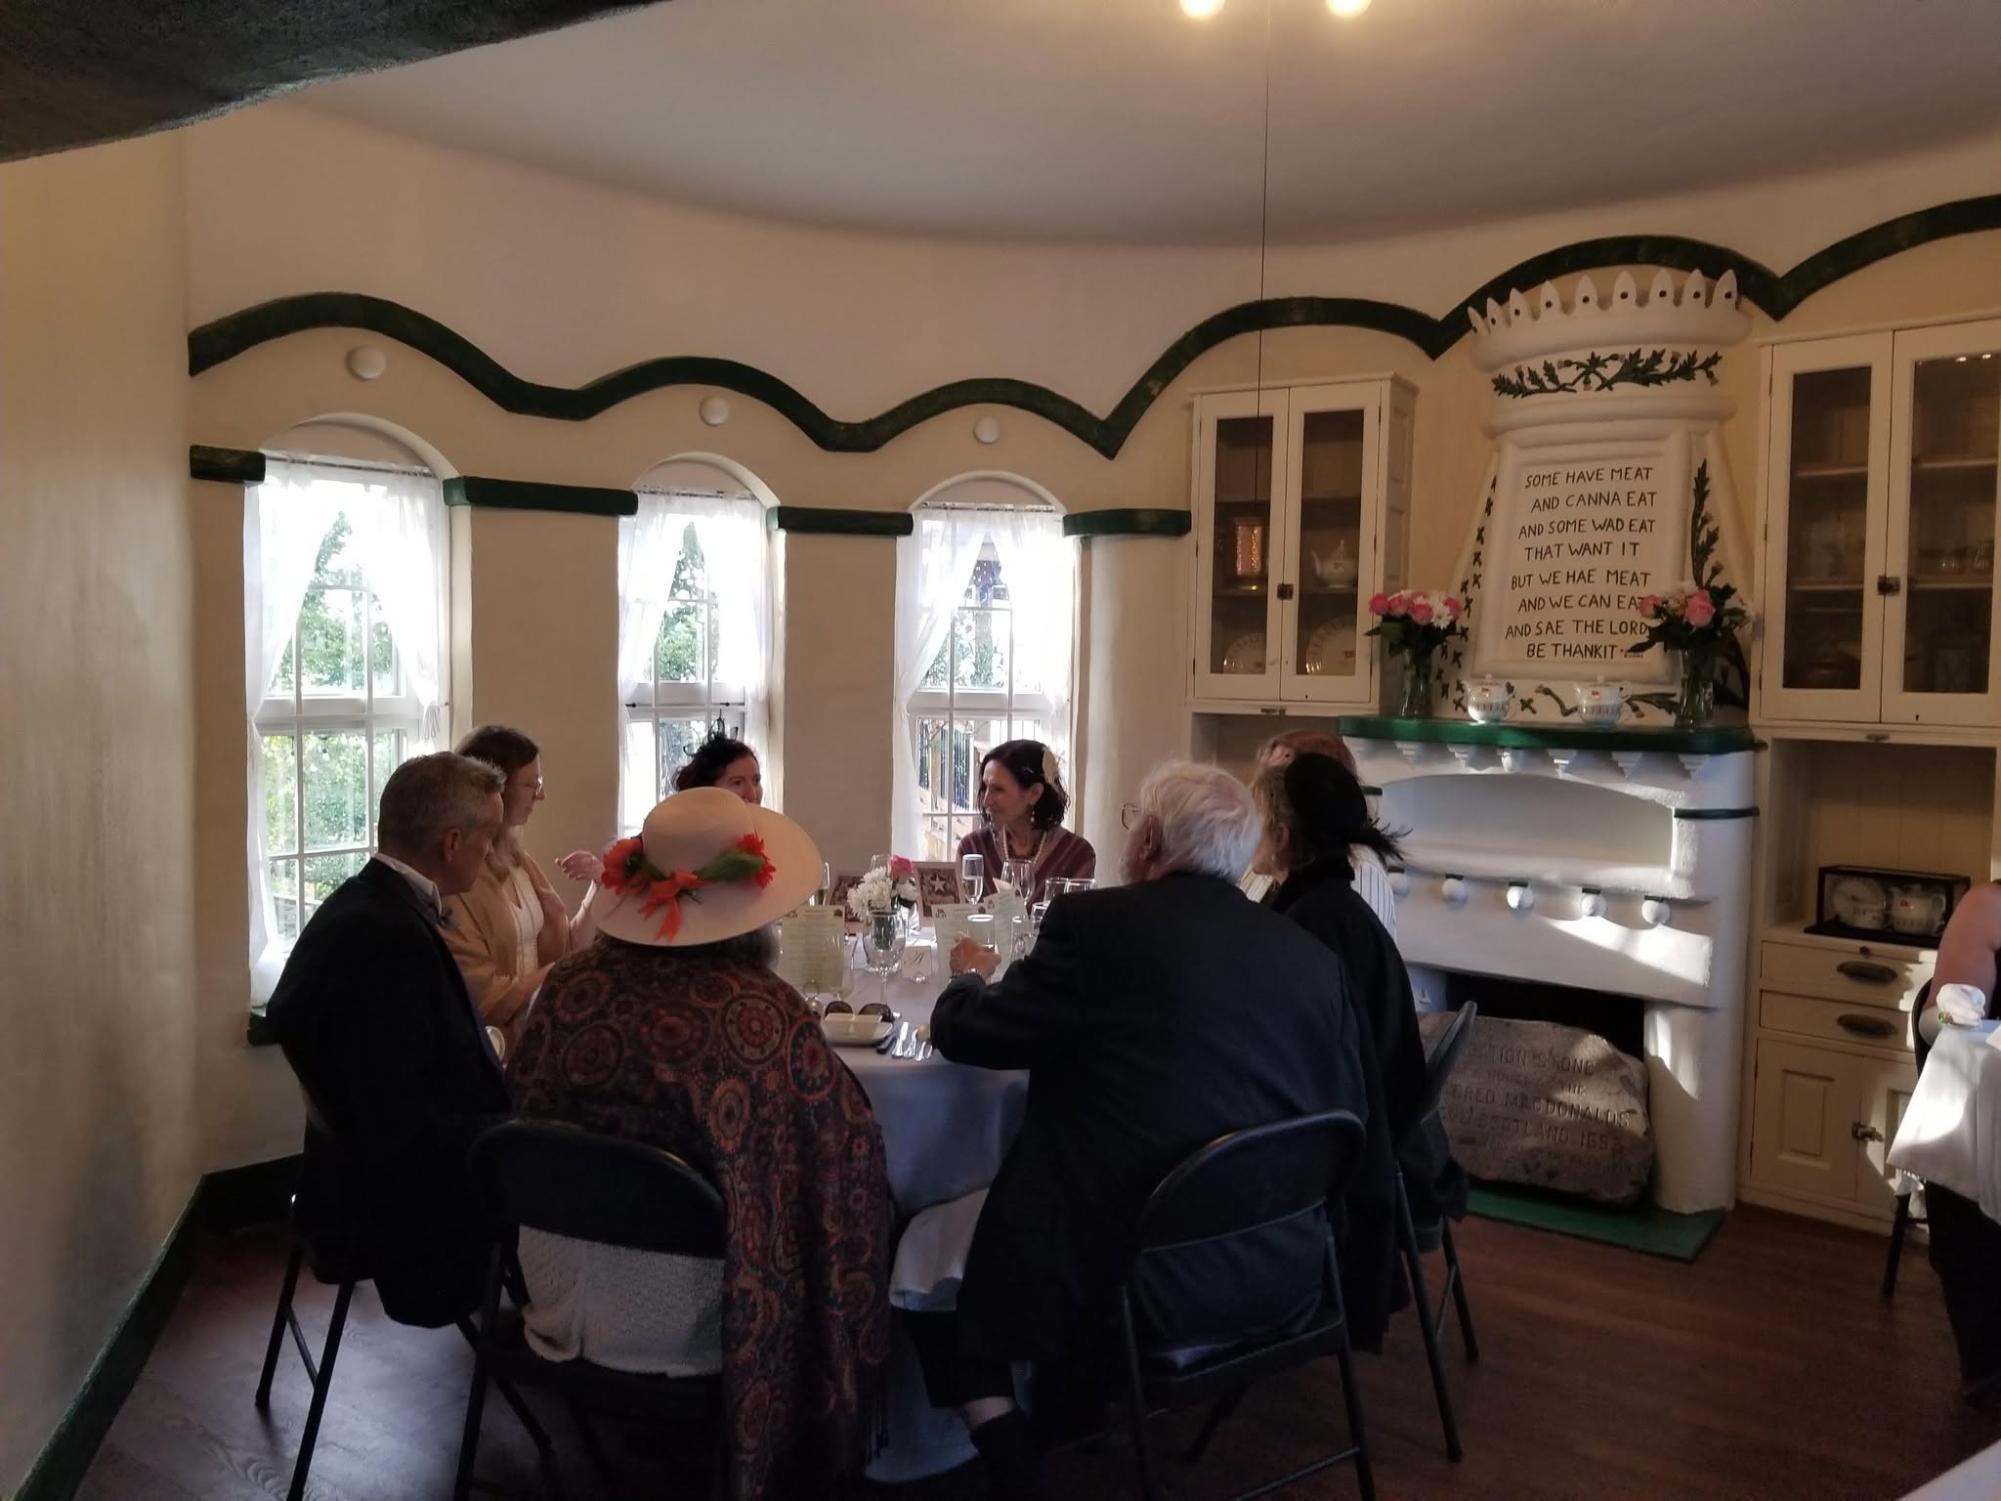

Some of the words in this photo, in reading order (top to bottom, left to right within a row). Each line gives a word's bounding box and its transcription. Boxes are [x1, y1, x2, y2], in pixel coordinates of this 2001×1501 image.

[1525, 472, 1559, 488] SOME
[1565, 469, 1605, 484] HAVE
[1611, 467, 1653, 481] MEAT
[1531, 498, 1559, 512] AND
[1565, 493, 1621, 507] CANNA
[1627, 491, 1657, 507] EAT
[1519, 526, 1543, 539] AND
[1549, 519, 1587, 534] SOME
[1592, 518, 1624, 532] WAD
[1629, 519, 1656, 533] EAT
[1524, 544, 1564, 561] THAT
[1568, 542, 1613, 556] WANT
[1622, 542, 1640, 556] IT
[1512, 574, 1533, 589] BUT
[1539, 570, 1561, 584] WE
[1566, 569, 1596, 584] HAE
[1606, 570, 1650, 587] MEAT
[1518, 598, 1545, 612] AND
[1550, 596, 1573, 609] WE
[1578, 596, 1611, 608] CAN
[1617, 596, 1643, 609] EA
[1505, 624, 1531, 639] AND
[1535, 620, 1564, 635] SAE
[1573, 620, 1604, 635] THE
[1610, 621, 1647, 635] LORD
[1527, 643, 1546, 658] BE
